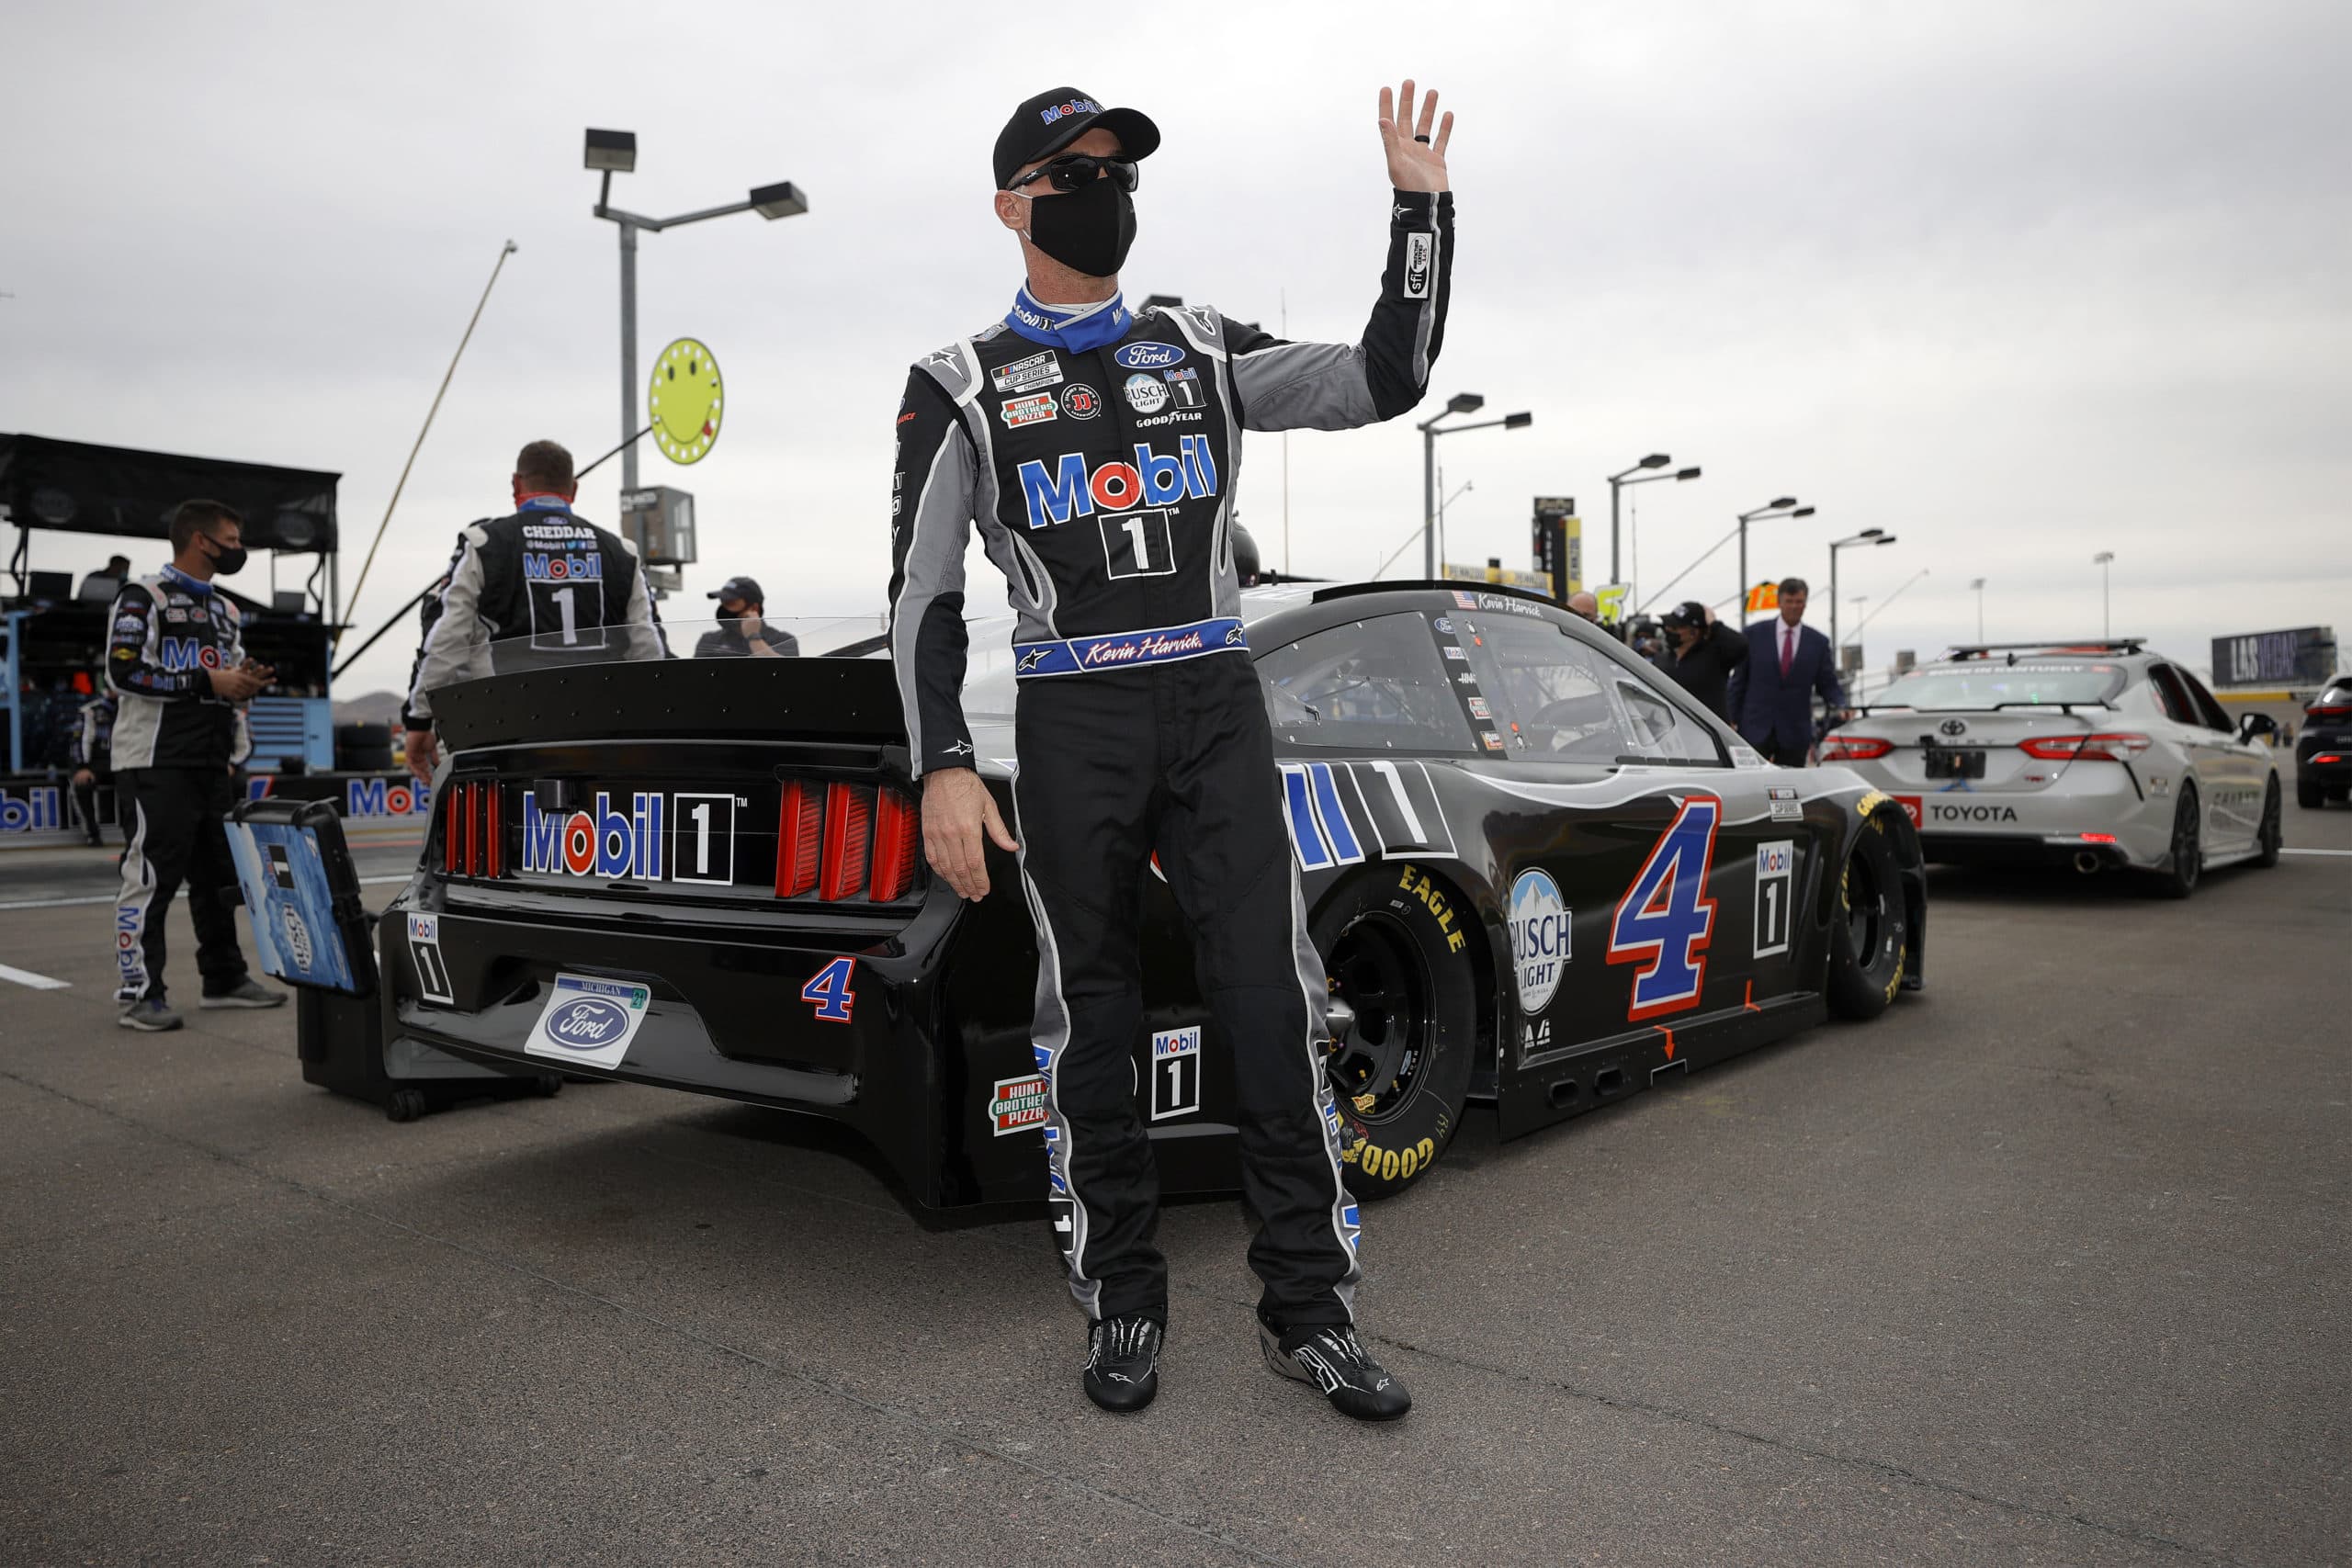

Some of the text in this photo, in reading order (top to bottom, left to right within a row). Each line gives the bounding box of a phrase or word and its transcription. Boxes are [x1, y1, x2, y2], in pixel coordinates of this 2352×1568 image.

[1012, 355, 1046, 372] NASCAR
[1128, 345, 1171, 366] Ford
[1004, 366, 1050, 386] CUP SERIES
[1023, 378, 1055, 390] CHAMPION
[1163, 367, 1197, 381] Mobil
[1013, 398, 1040, 410] HUNT
[1124, 383, 1170, 402] BUSCH
[1135, 398, 1160, 408] LIGHT
[1178, 381, 1193, 405] 1
[1006, 403, 1053, 418] BROTHERS
[1017, 411, 1046, 423] PIZZA
[1136, 411, 1202, 428] GOODYEAR
[1016, 434, 1218, 530] Mobil
[522, 525, 597, 540] CHEDDAR
[1120, 516, 1150, 570] 1
[522, 552, 603, 580] Mobil
[1478, 593, 1503, 610] Kevin
[552, 587, 577, 645] 1
[162, 637, 230, 671] Mob
[1084, 640, 1136, 665] Kevin
[2231, 637, 2258, 682] LAS
[0, 786, 60, 831] bil
[345, 778, 431, 817] Mob
[1931, 805, 2018, 822] TOYOTA
[522, 790, 664, 880] Mobil
[691, 803, 710, 874] 1
[1758, 846, 1791, 873] Mobil
[1398, 864, 1466, 953] EAGLE
[1605, 794, 1722, 1022] 4
[1766, 882, 1778, 943] 1
[410, 918, 436, 939] Mobil
[1510, 913, 1570, 967] BUSCH
[118, 907, 142, 983] Mobil
[419, 946, 440, 992] 1
[1521, 963, 1555, 990] LIGHT
[581, 981, 621, 996] MICHIGAN
[800, 955, 856, 1024] 4
[559, 1003, 614, 1040] Ford
[1155, 1032, 1197, 1055] Mobil
[1009, 1081, 1043, 1100] HUNT
[1168, 1060, 1182, 1108] 1
[995, 1093, 1046, 1114] BROTHE
[1009, 1106, 1045, 1125] PIZZA
